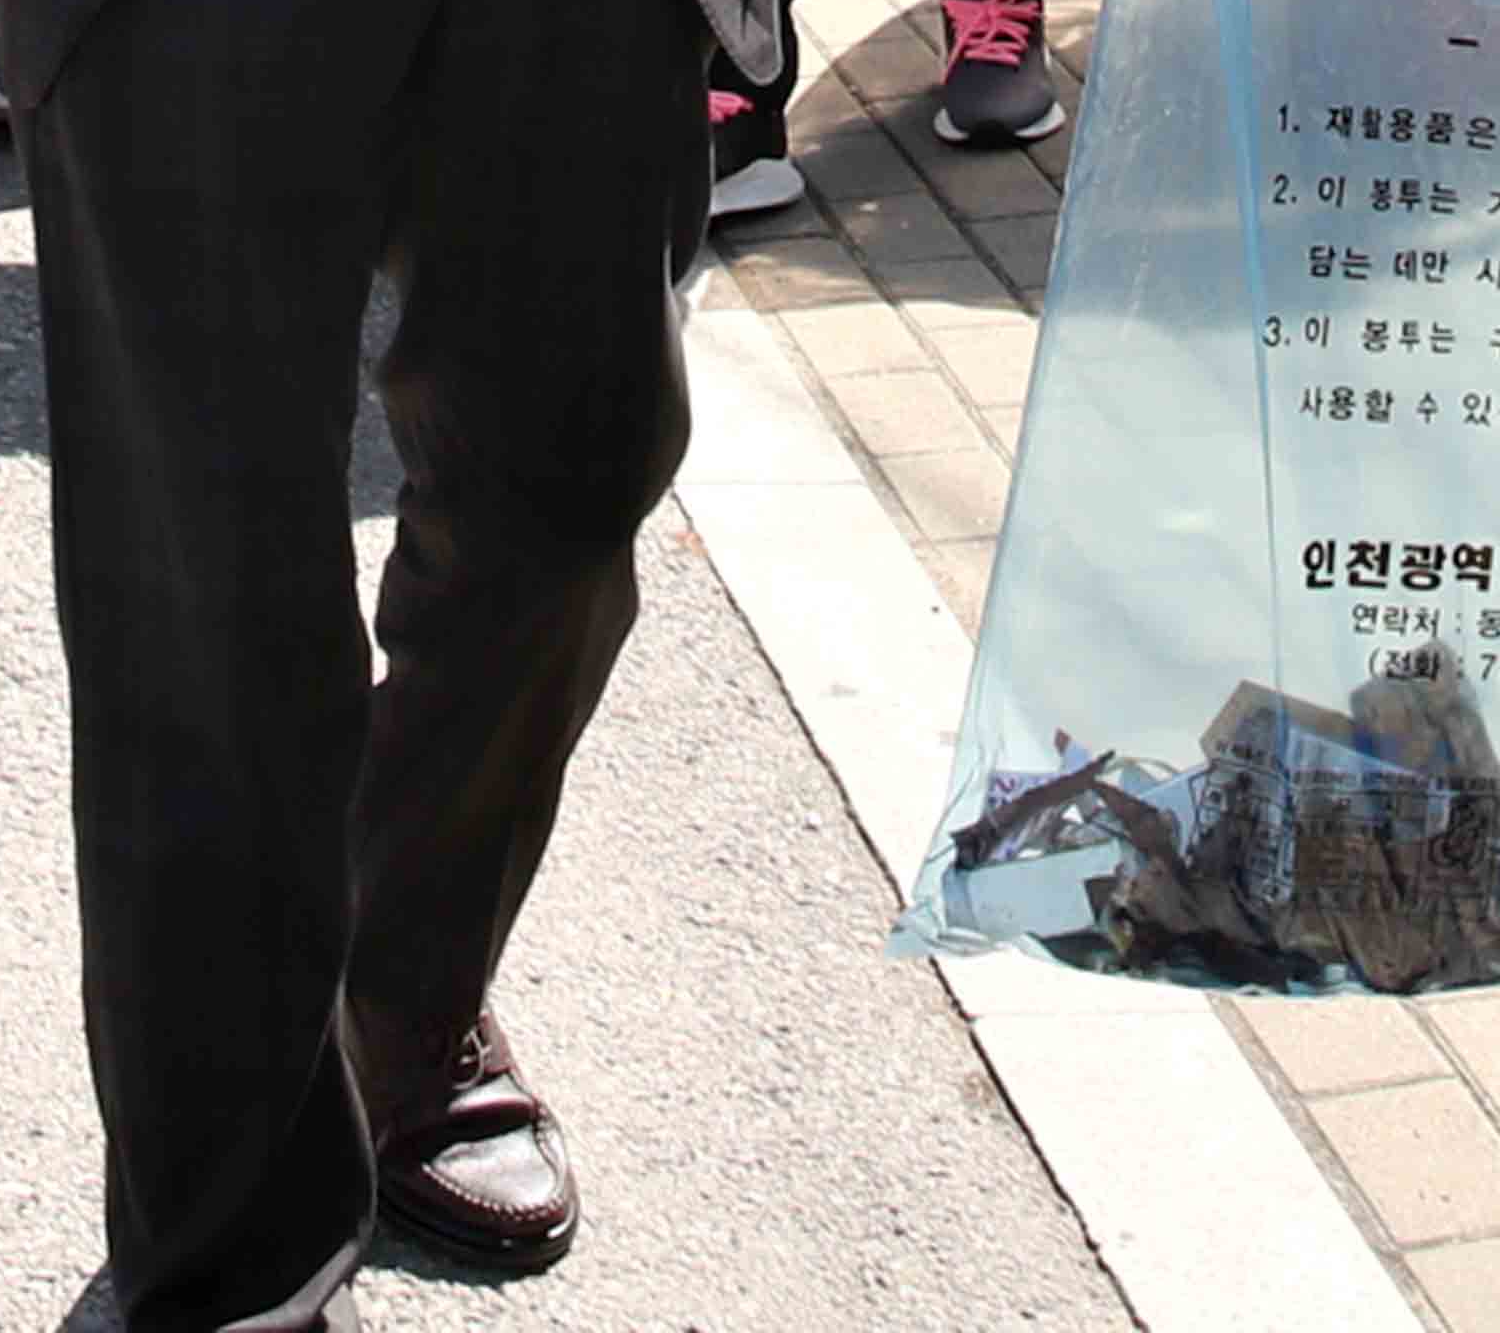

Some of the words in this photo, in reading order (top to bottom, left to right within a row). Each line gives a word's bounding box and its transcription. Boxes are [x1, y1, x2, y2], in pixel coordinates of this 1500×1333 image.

[1277, 103, 1300, 134] 1.
[1325, 105, 1499, 152] 재활용품은
[1271, 173, 1298, 206] 2.
[1317, 175, 1347, 209] 이
[1368, 176, 1460, 215] 봉투는
[1307, 244, 1373, 281] 담는
[1393, 248, 1451, 285] 데만
[1261, 315, 1291, 348] 3.
[1304, 315, 1331, 349] 이
[1360, 318, 1457, 355] 봉투는
[1299, 385, 1394, 423] 사용할
[1415, 391, 1440, 424] 수
[1350, 602, 1442, 639] 연락처
